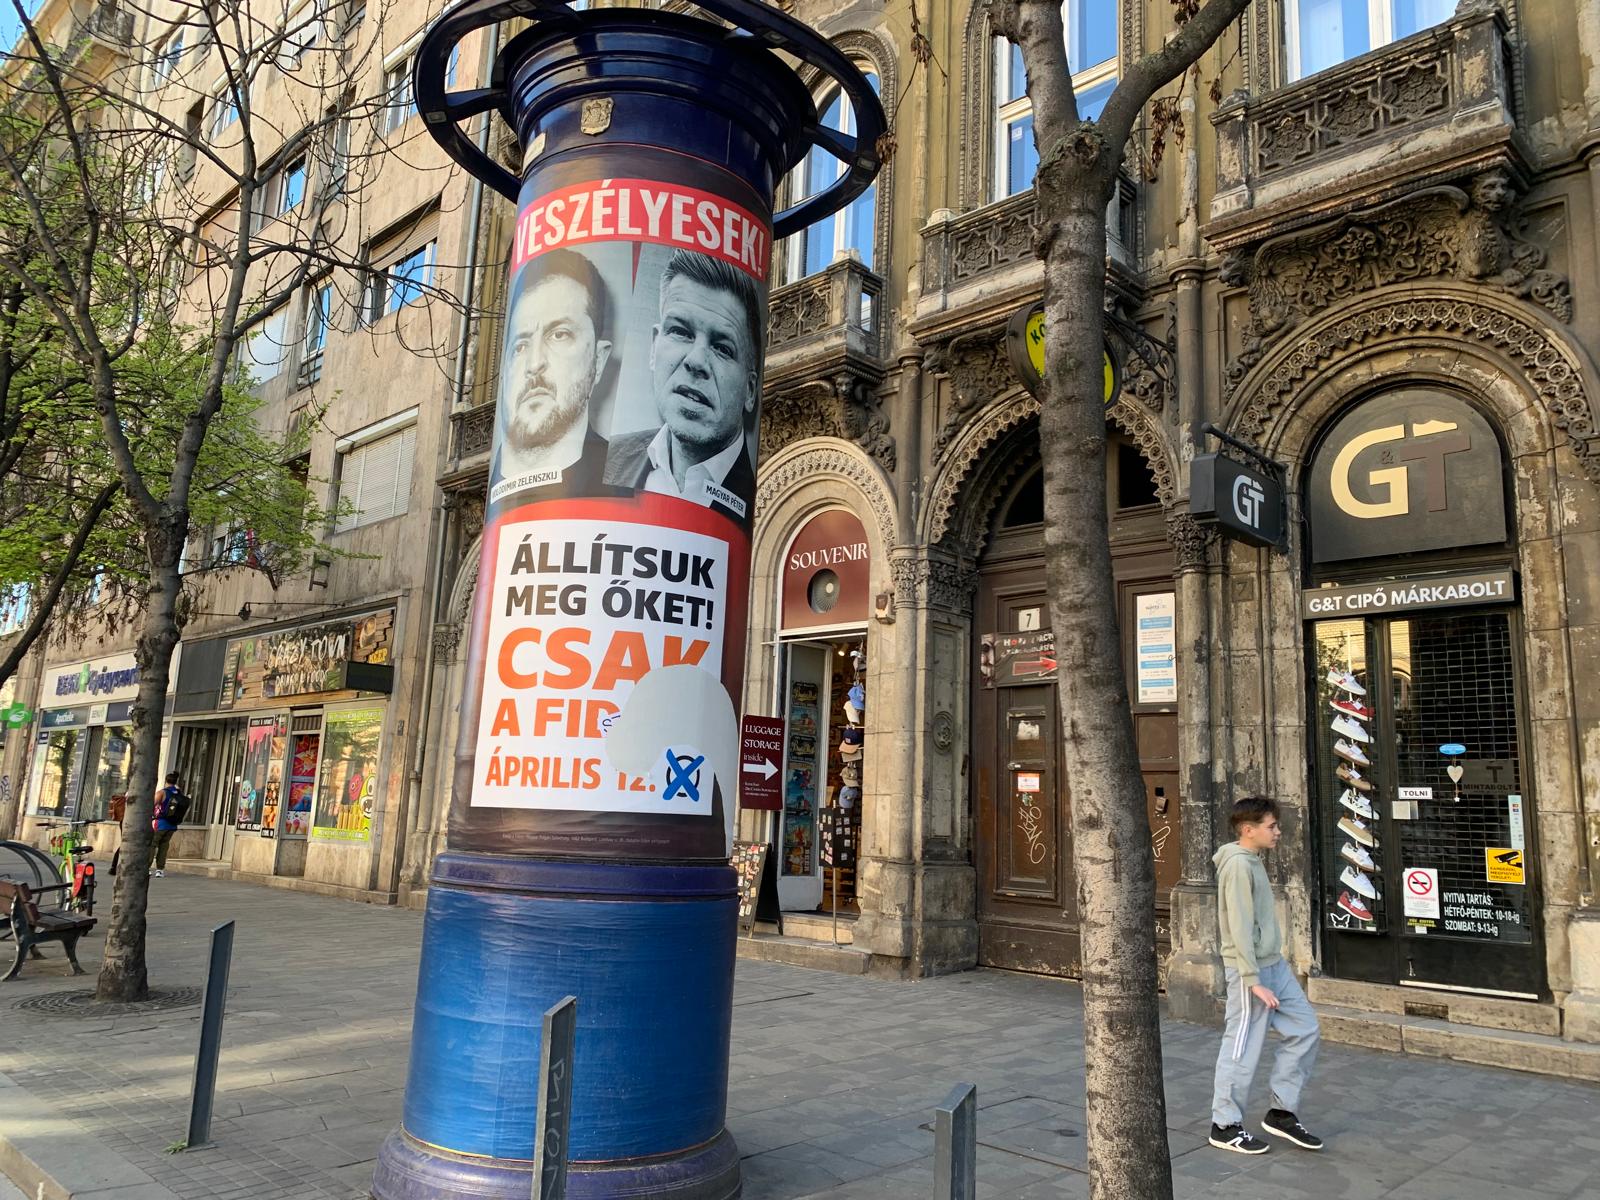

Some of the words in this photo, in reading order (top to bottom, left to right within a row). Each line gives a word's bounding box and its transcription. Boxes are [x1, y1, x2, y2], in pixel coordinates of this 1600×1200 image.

[516, 179, 765, 276] VESZÉLYESEK!
[518, 471, 558, 488] ZELENSZKIJ
[706, 484, 730, 503] MAGYAR
[731, 496, 744, 513] PÉTER
[510, 533, 715, 589] ÁLLÍTSUK
[790, 542, 868, 570] SOUVENIR
[505, 583, 587, 617] MEG
[602, 579, 714, 630] ŐKET!
[1309, 595, 1343, 612] G&T
[1346, 587, 1387, 609] CIPŐ
[1391, 580, 1506, 605] MÁRKABOLT
[1026, 612, 1032, 628] 7
[490, 698, 521, 737] A
[533, 698, 621, 738] FID
[745, 724, 782, 736] LUGGAGE
[744, 738, 781, 751] STORAGE
[743, 752, 764, 762] inside
[485, 746, 602, 790] ÁPRILIS
[1403, 789, 1429, 797] TOLNI
[1443, 892, 1465, 904] NYITVA
[1466, 891, 1494, 906] TARTÁS:
[1444, 905, 1495, 920] HÉTFŐ-PÉNTEK:
[1495, 910, 1520, 924] 10-18-ig
[1445, 920, 1477, 933] SZOMBAT:
[1477, 922, 1499, 937] 9-13-ig
